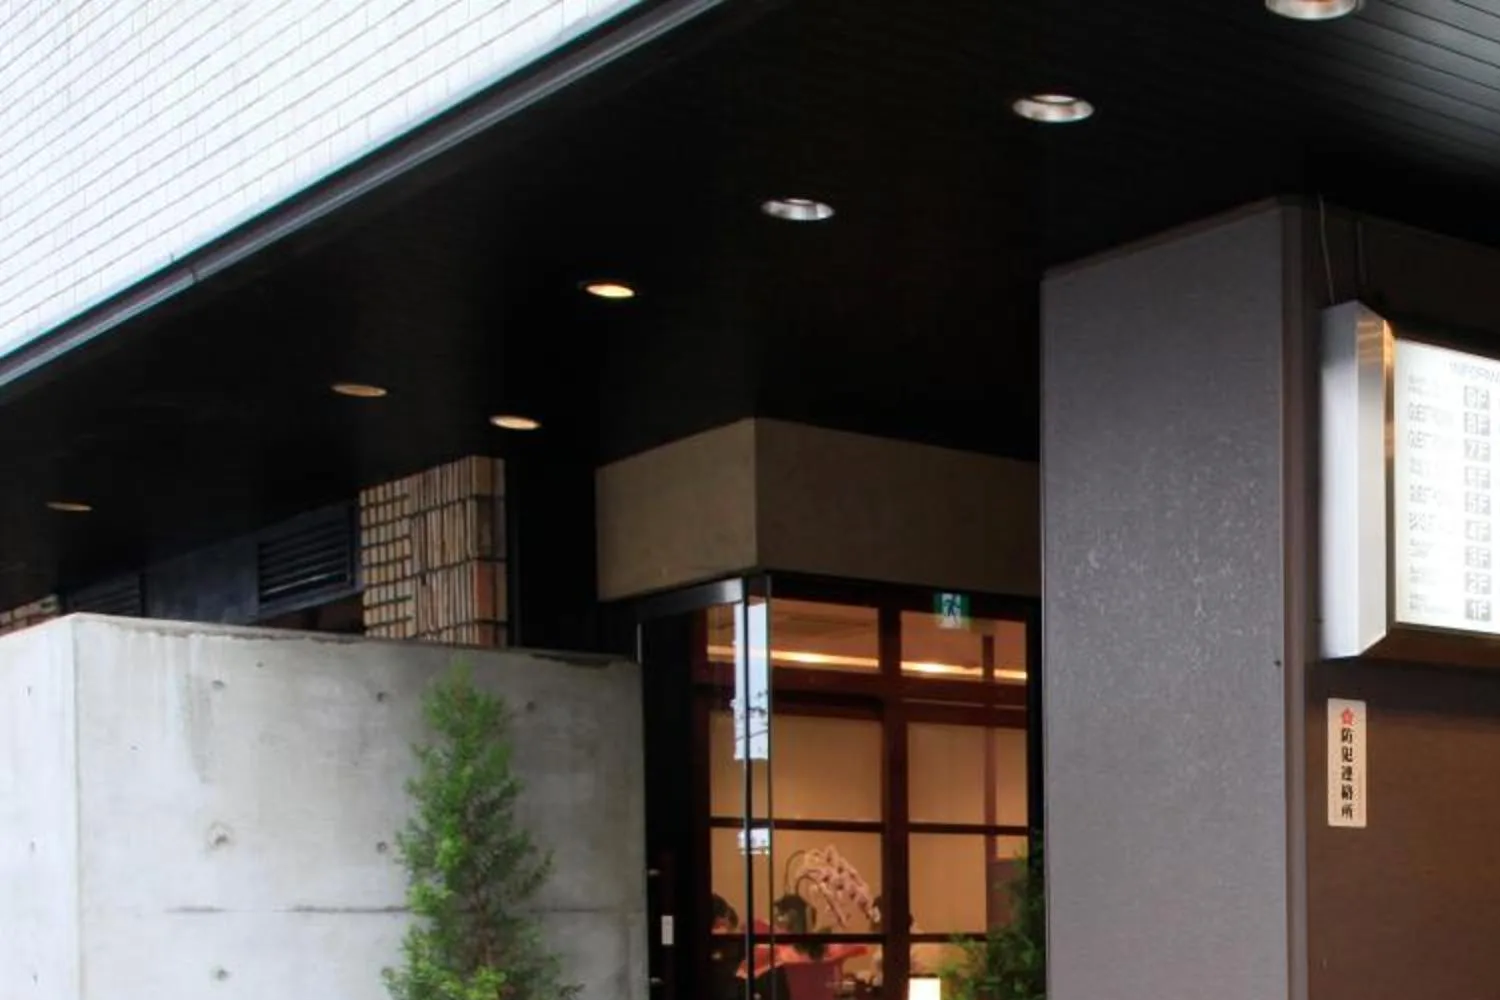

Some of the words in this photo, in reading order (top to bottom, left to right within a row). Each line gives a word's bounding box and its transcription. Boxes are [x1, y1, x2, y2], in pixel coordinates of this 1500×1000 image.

[1340, 727, 1354, 820] 防犯連絡所
